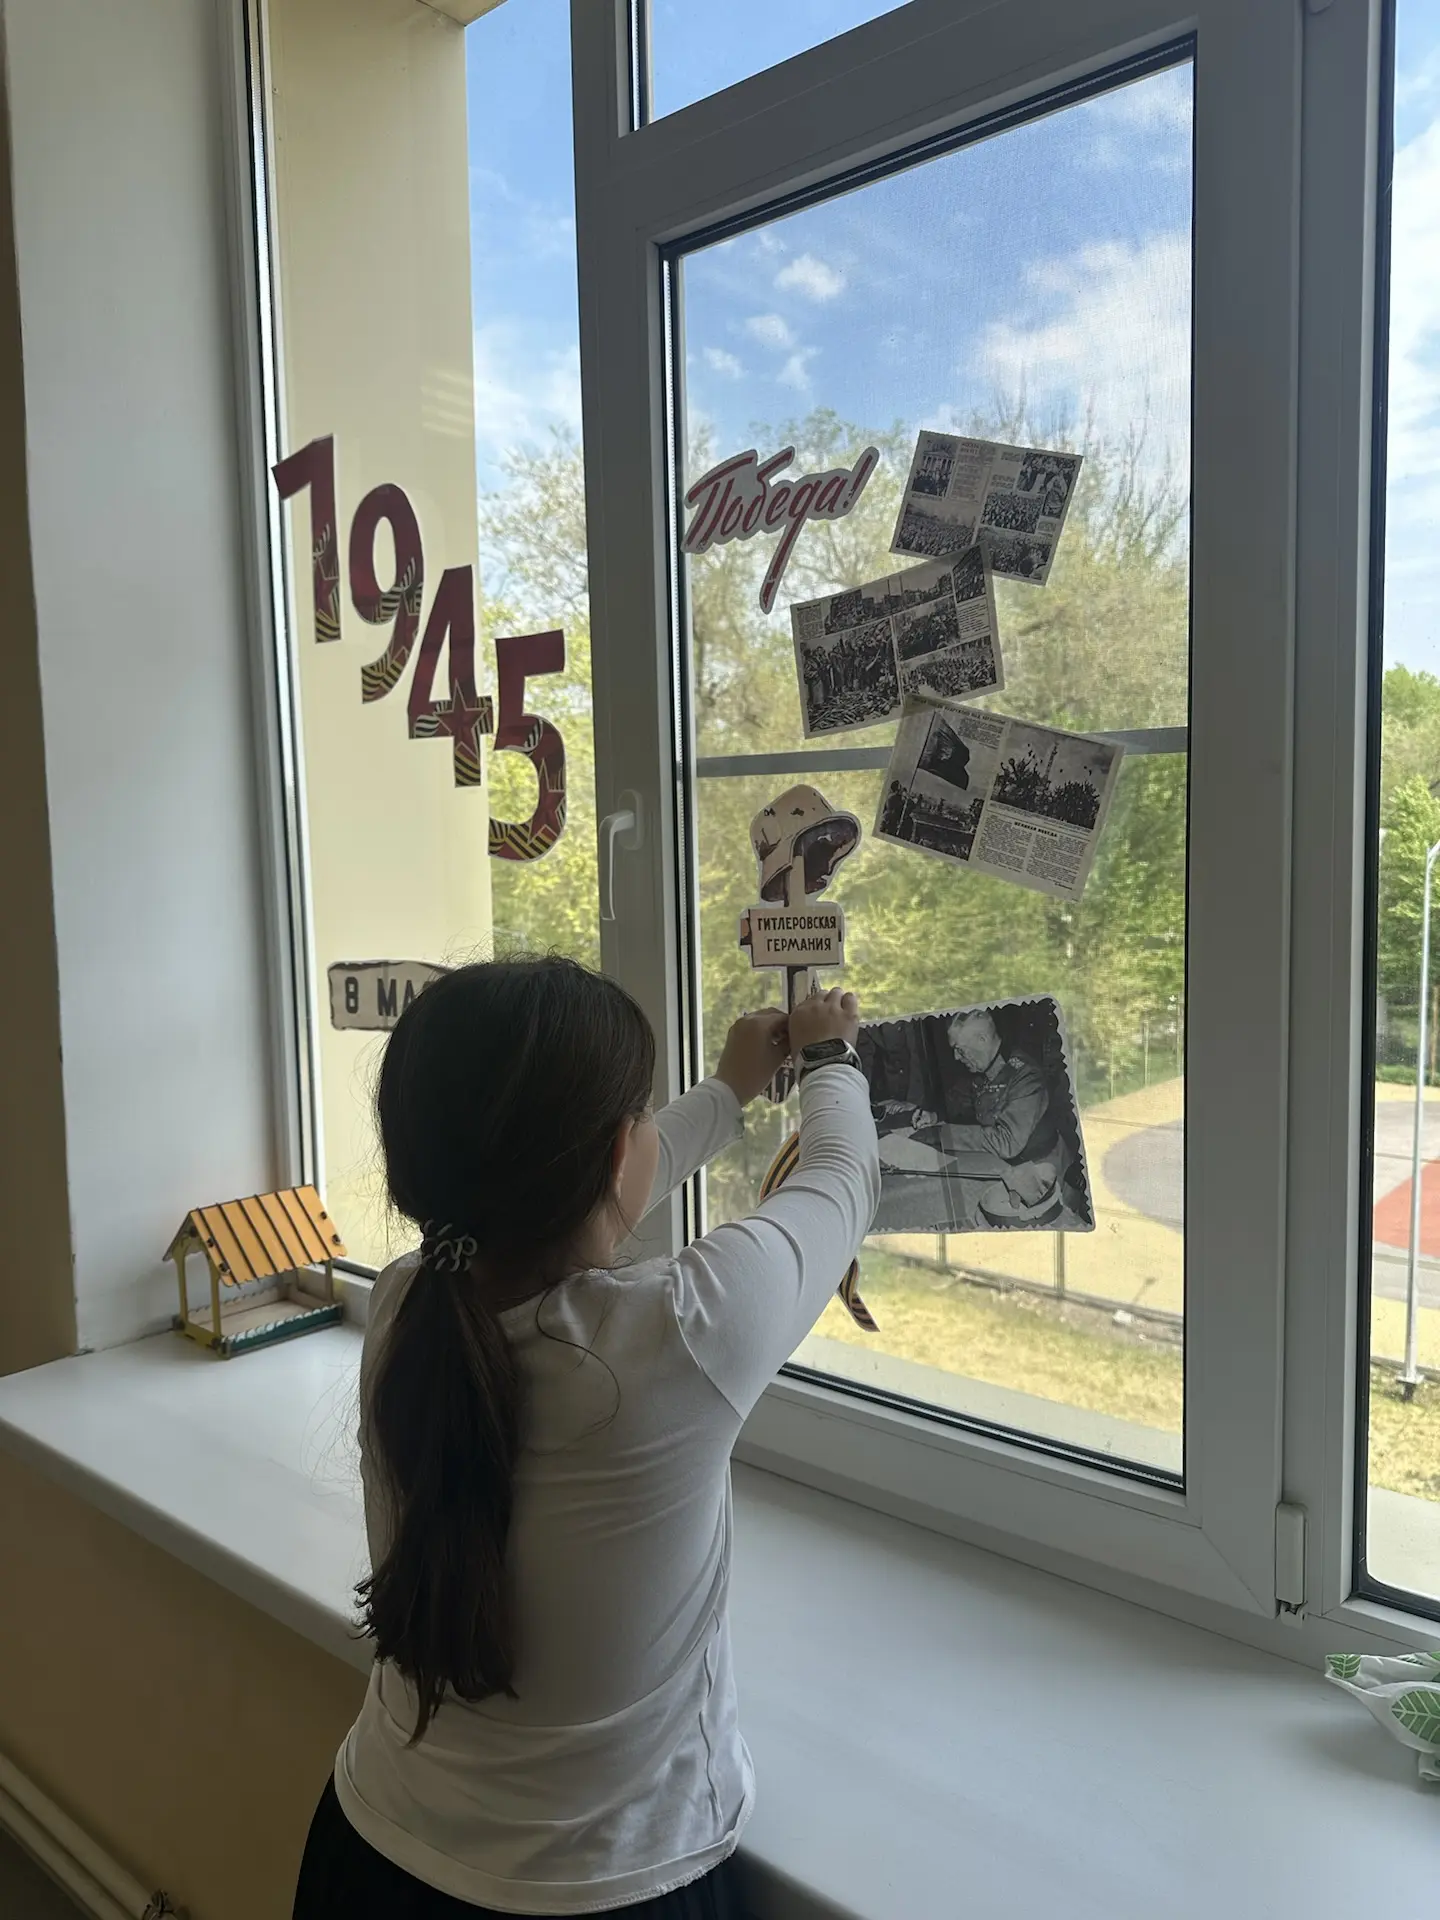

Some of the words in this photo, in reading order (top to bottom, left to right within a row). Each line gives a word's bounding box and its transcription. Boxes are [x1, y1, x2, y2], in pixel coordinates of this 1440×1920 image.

[686, 450, 874, 608] Победа!
[272, 433, 567, 863] 1945
[757, 916, 837, 931] ГИТЛЕРОВСКАЯ
[767, 938, 832, 952] ГЕРМАНИЯ
[345, 976, 359, 1014] 8
[377, 978, 437, 1017] МА
